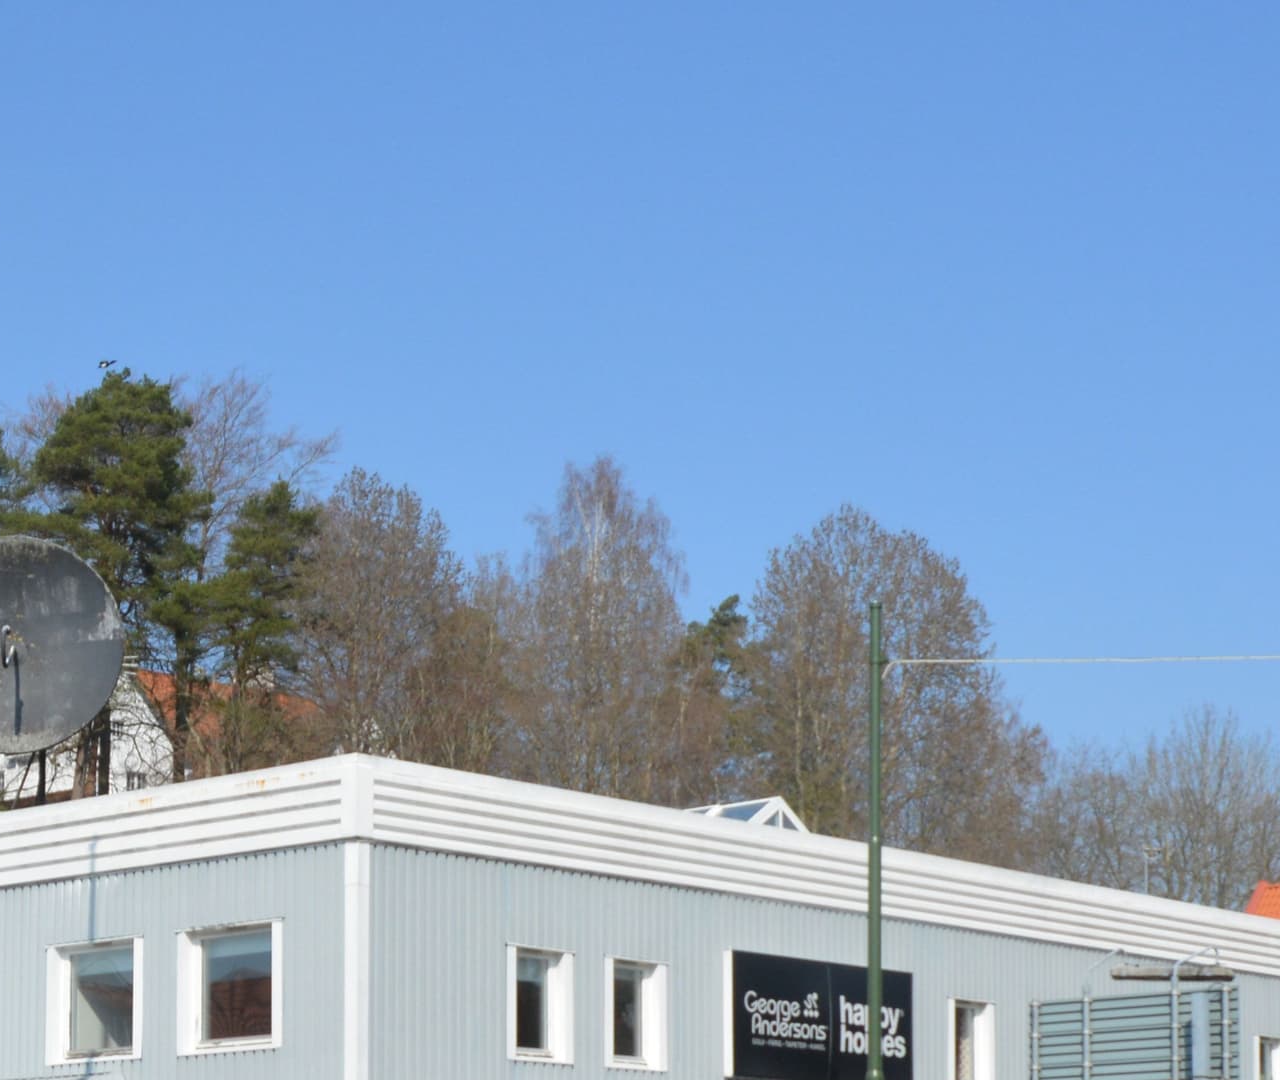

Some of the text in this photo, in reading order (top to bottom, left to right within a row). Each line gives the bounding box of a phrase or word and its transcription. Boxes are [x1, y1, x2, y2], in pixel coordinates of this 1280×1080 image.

[744, 990, 801, 1023] George
[839, 995, 900, 1035] hapy
[751, 1013, 827, 1041] Andersons
[839, 1023, 907, 1059] hoes
